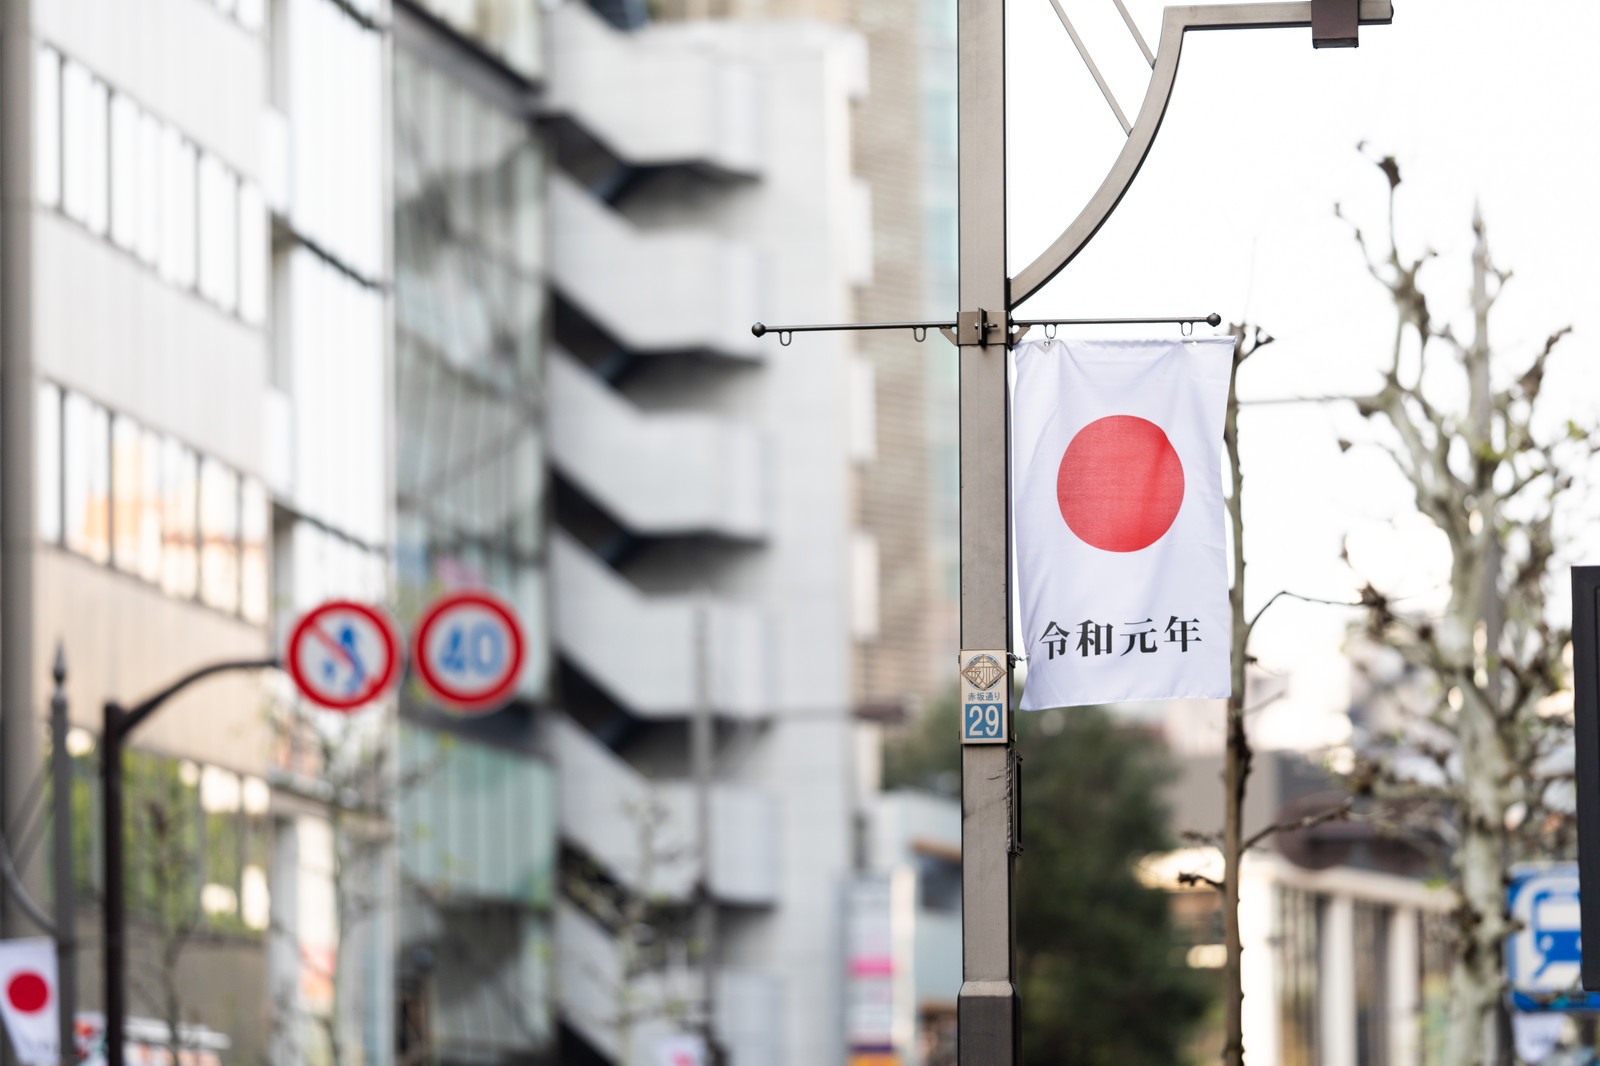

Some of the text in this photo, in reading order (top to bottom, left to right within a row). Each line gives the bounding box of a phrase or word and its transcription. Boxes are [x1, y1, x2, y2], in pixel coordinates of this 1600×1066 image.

[438, 621, 505, 676] 40
[1039, 615, 1202, 660] 令和元年
[967, 692, 1000, 701] 赤坂通り
[969, 705, 999, 736] 29
